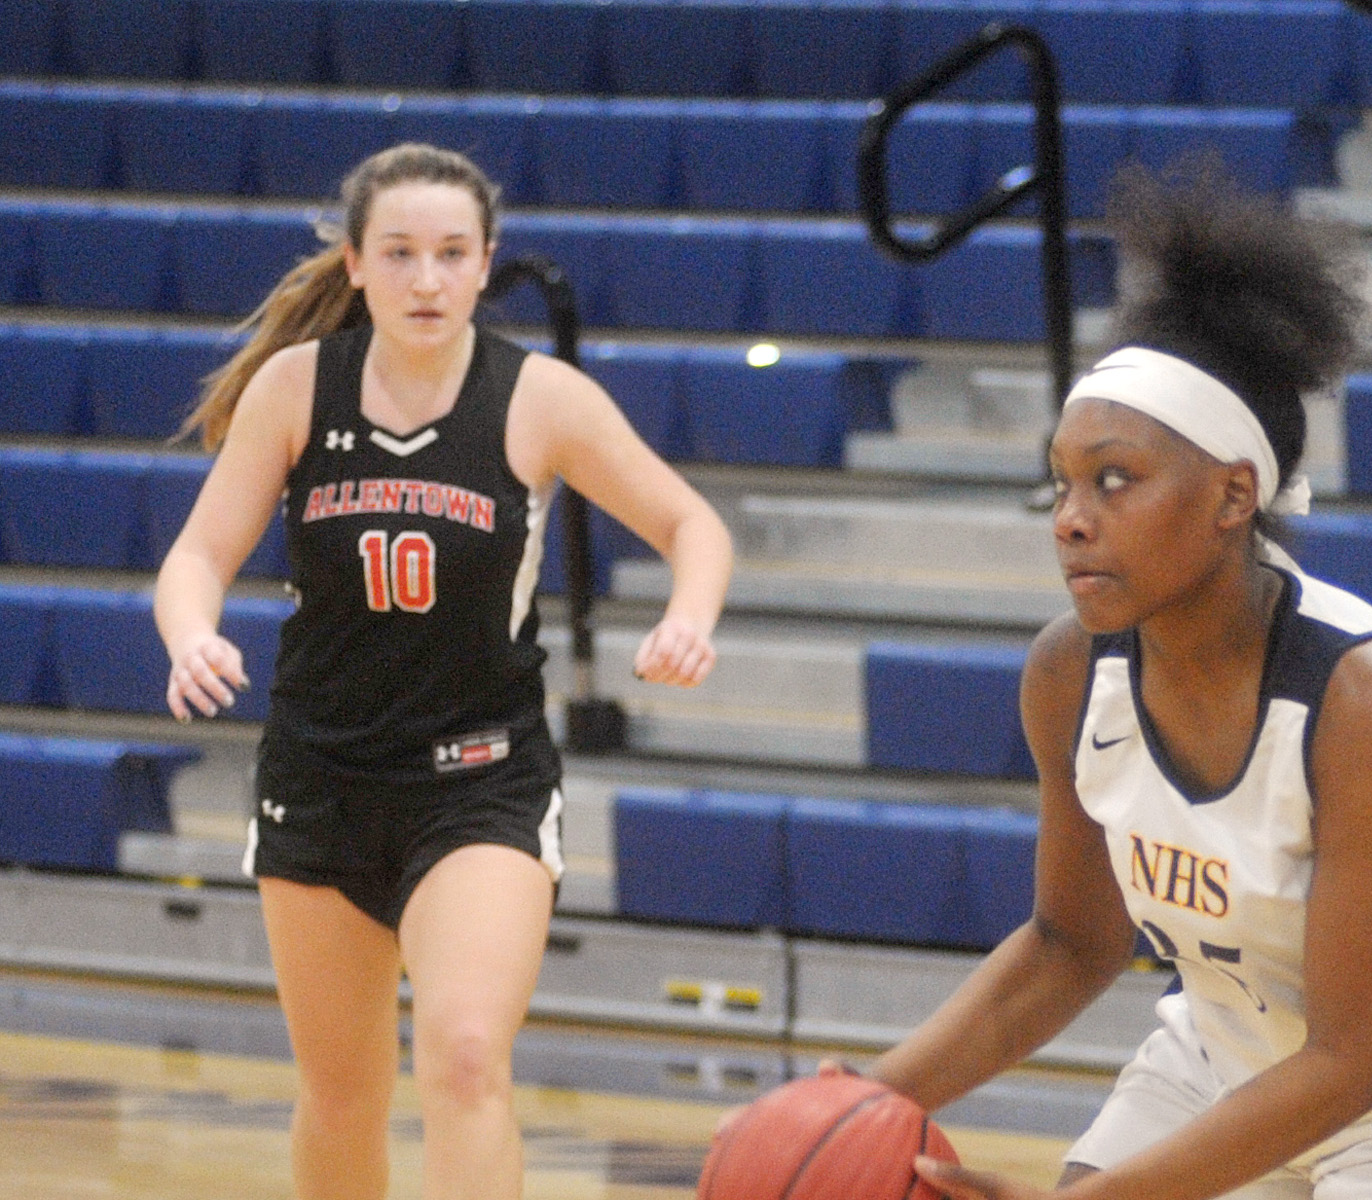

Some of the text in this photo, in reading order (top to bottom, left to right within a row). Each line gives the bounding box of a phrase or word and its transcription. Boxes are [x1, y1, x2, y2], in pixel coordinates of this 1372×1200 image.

[302, 477, 496, 533] ALLENTOWN
[358, 529, 437, 614] 10
[1129, 833, 1230, 919] NHS
